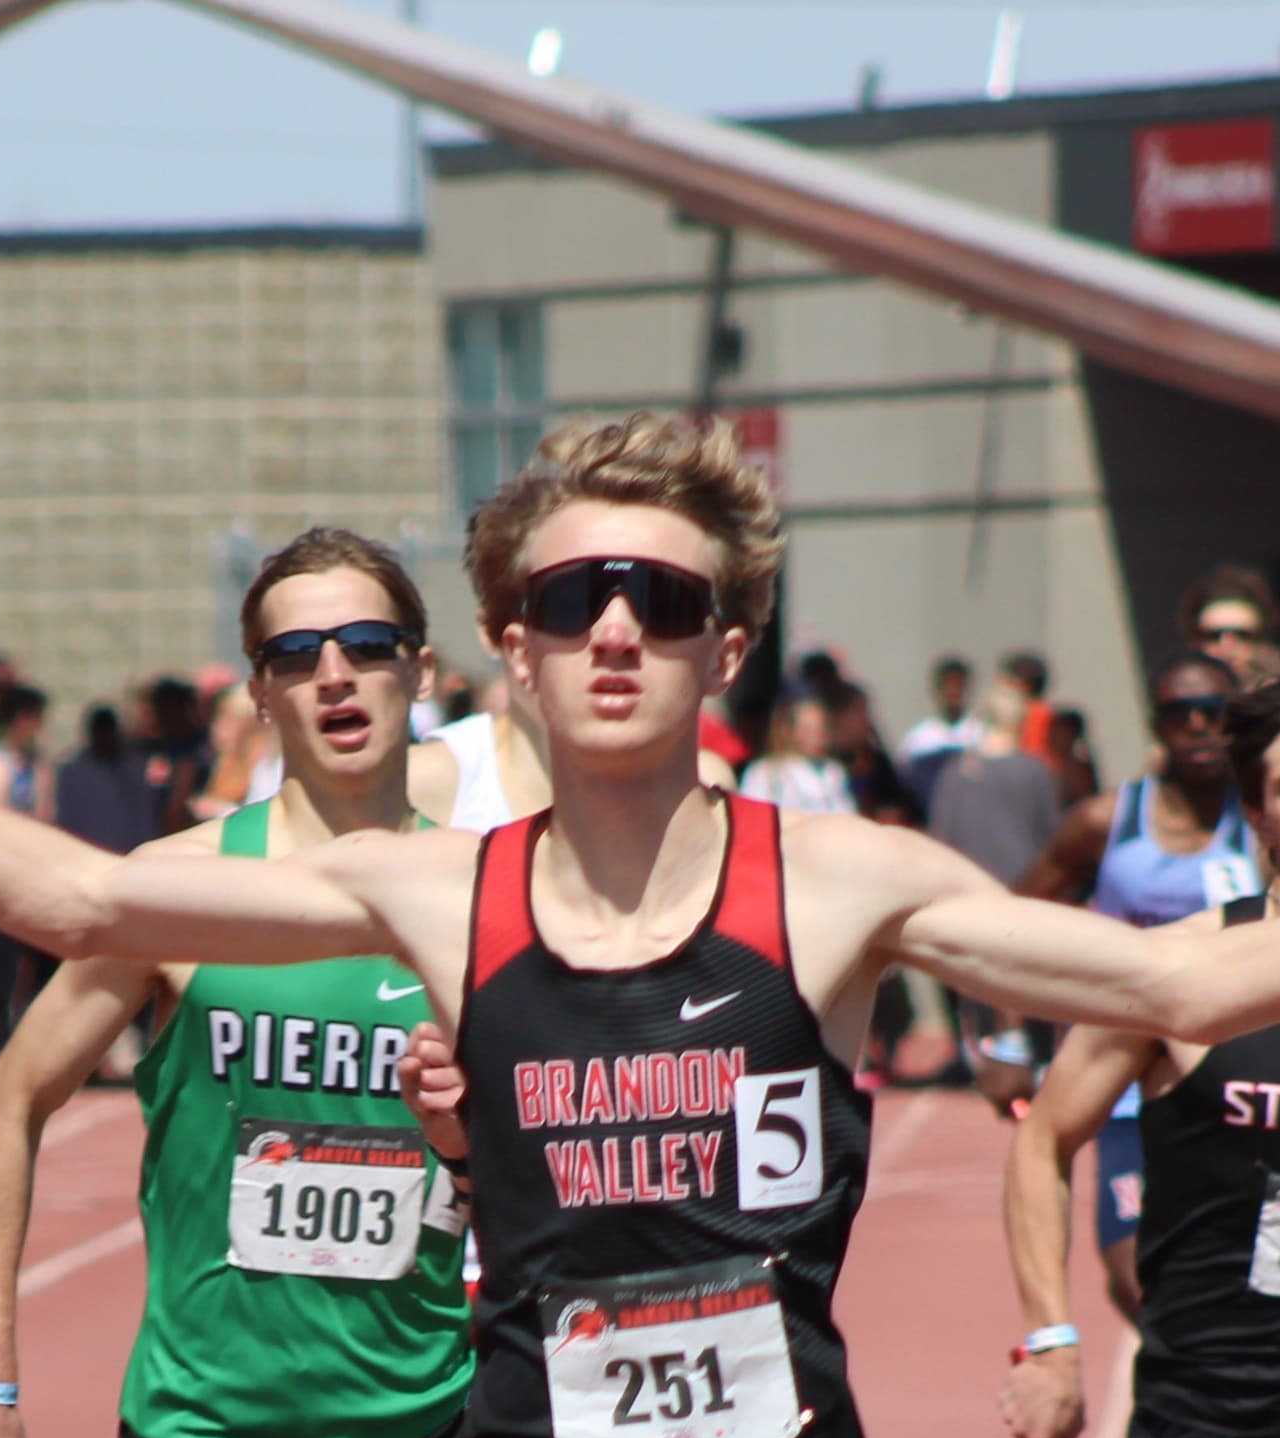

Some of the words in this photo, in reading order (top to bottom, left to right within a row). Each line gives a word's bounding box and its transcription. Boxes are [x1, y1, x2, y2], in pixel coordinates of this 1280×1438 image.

[208, 1008, 410, 1097] PIERR
[513, 1046, 746, 1130] BRANDON
[544, 1130, 722, 1208] VALLEY
[753, 1078, 807, 1180] 5
[260, 1183, 397, 1246] 1903
[605, 1344, 736, 1427] 251
